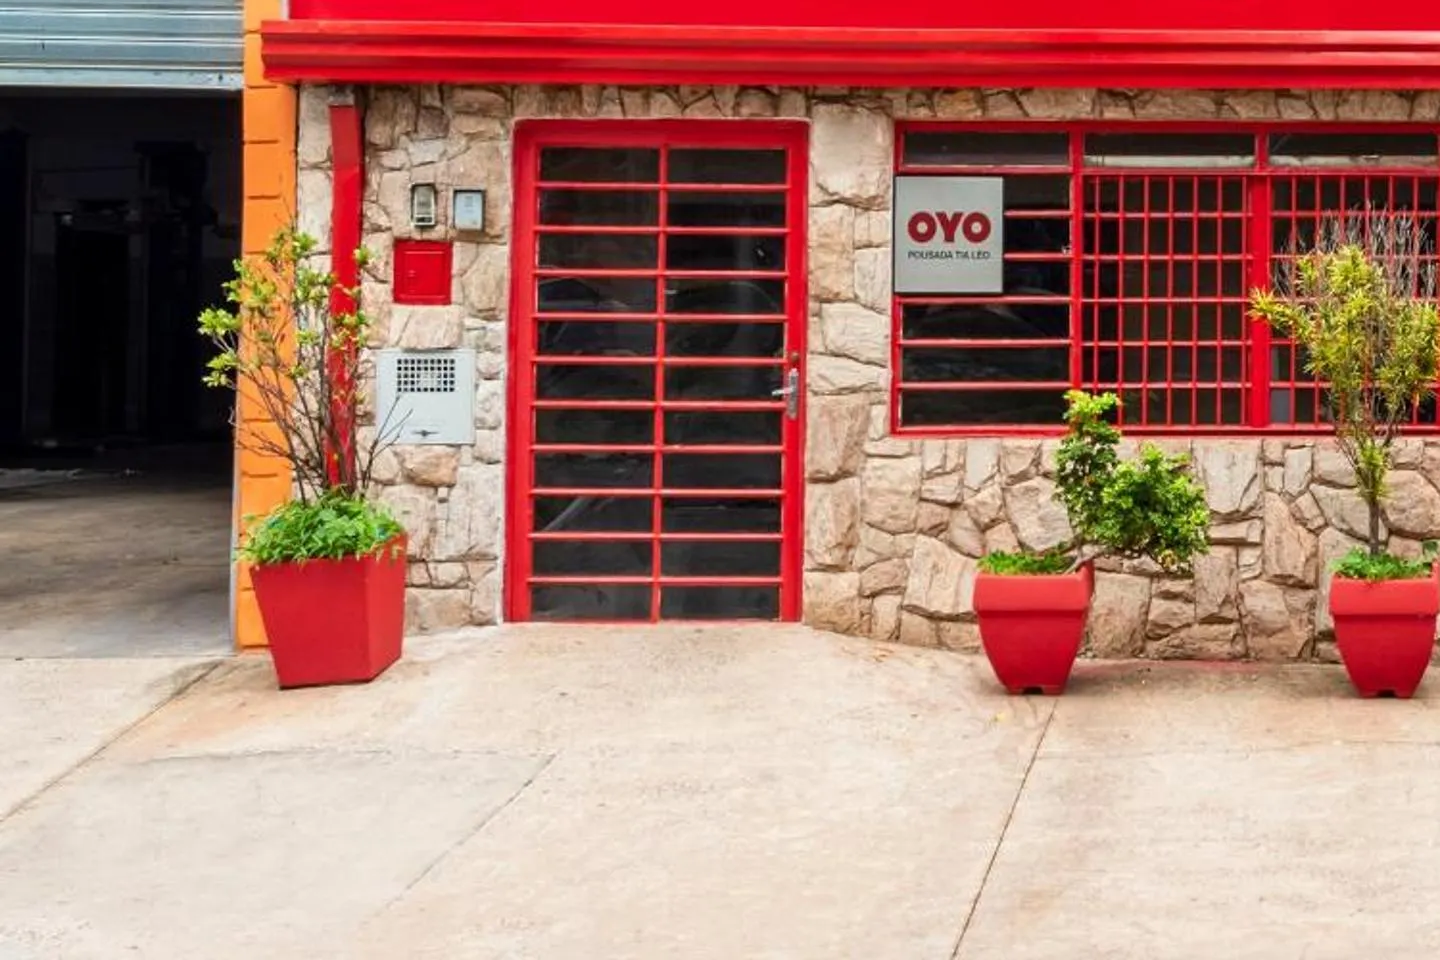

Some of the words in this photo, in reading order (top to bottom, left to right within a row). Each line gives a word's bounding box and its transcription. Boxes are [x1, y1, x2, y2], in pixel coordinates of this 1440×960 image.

[908, 212, 991, 243] OYO
[907, 249, 953, 260] POUSADA
[955, 250, 970, 260] TIA
